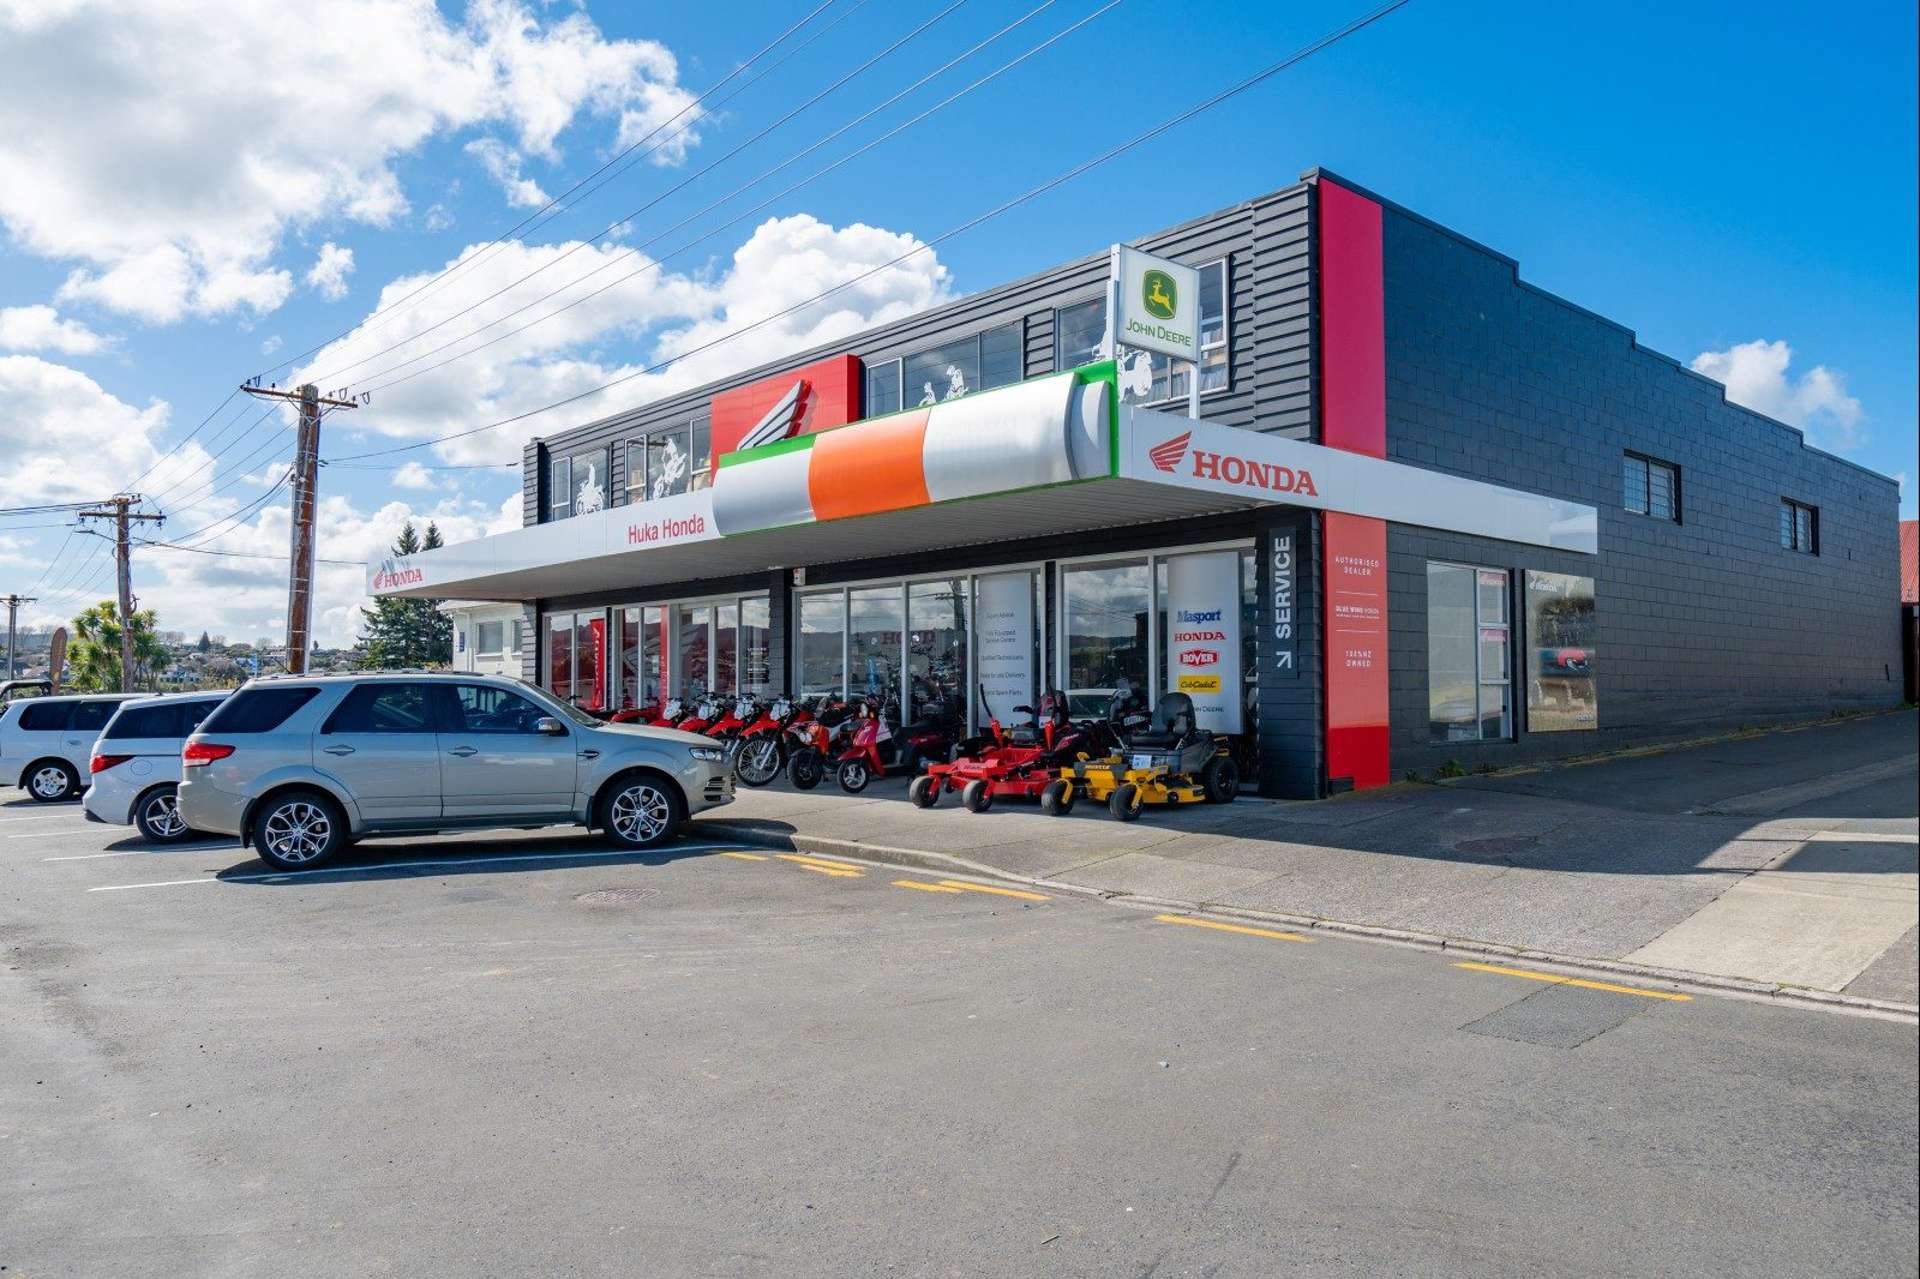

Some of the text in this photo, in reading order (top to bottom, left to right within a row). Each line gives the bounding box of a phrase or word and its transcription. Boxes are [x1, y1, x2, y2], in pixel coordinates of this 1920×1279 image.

[1126, 318, 1192, 347] JOHN DEERE
[1192, 450, 1318, 497] HONDA
[628, 513, 705, 545] Huka Honda
[1335, 556, 1380, 569] AUTHORISED
[1343, 566, 1371, 576] DEALER
[383, 567, 423, 588] HONDA
[1274, 536, 1291, 639] SERVICE
[1177, 609, 1222, 624] Masport
[1174, 631, 1226, 642] HONDA
[1183, 654, 1214, 664] ROVER
